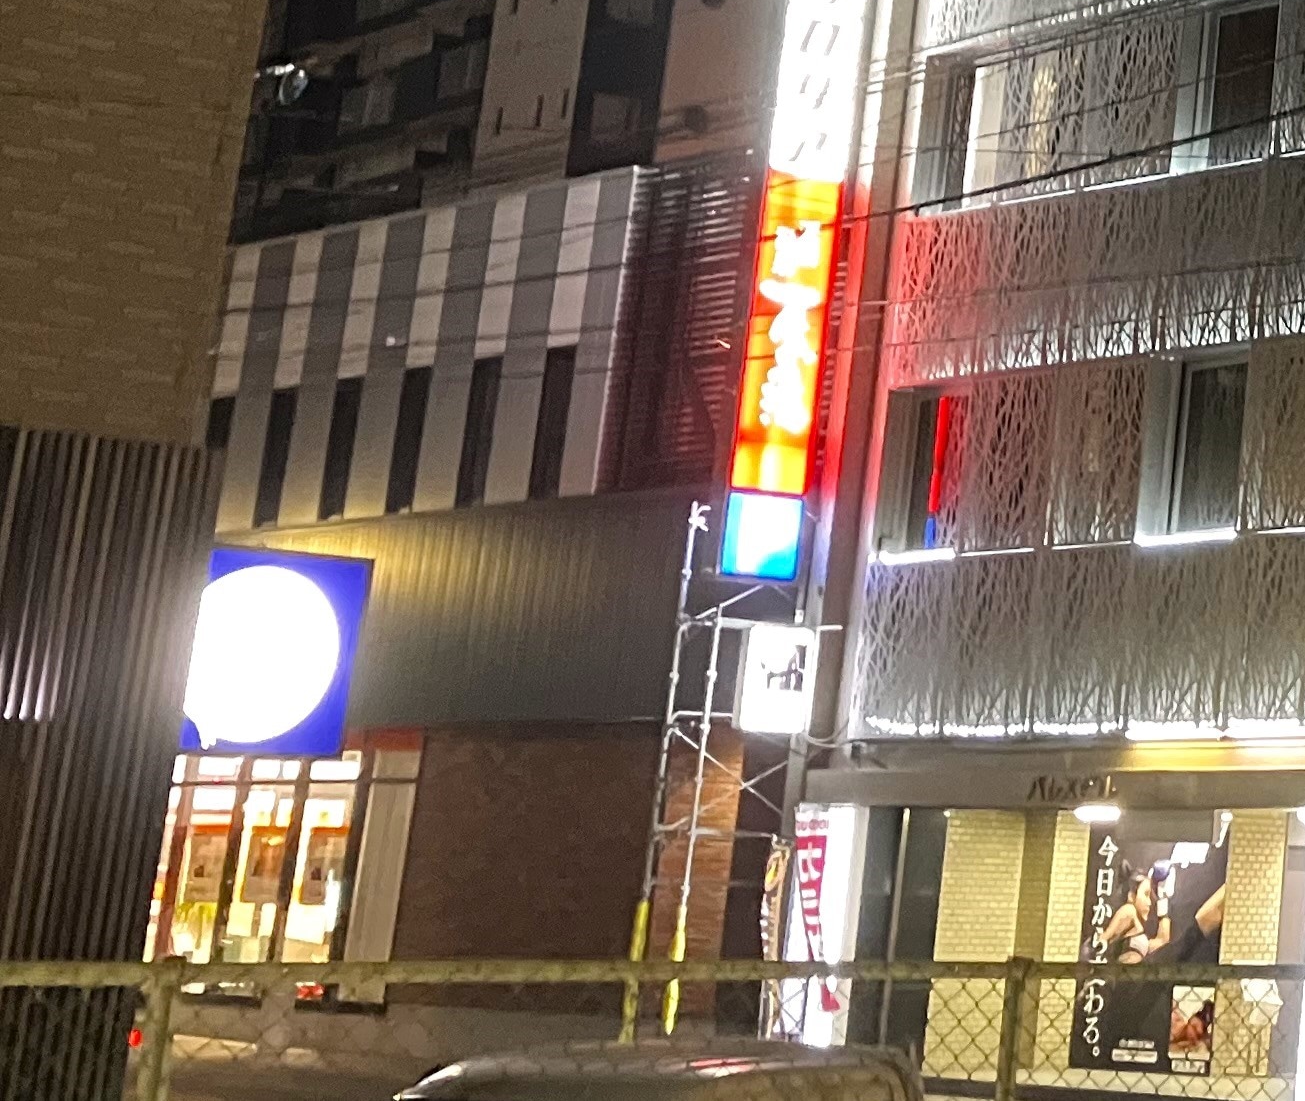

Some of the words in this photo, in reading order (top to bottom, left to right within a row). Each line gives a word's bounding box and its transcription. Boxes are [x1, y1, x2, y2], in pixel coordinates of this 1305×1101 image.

[1080, 834, 1120, 1059] 今日からわる。
